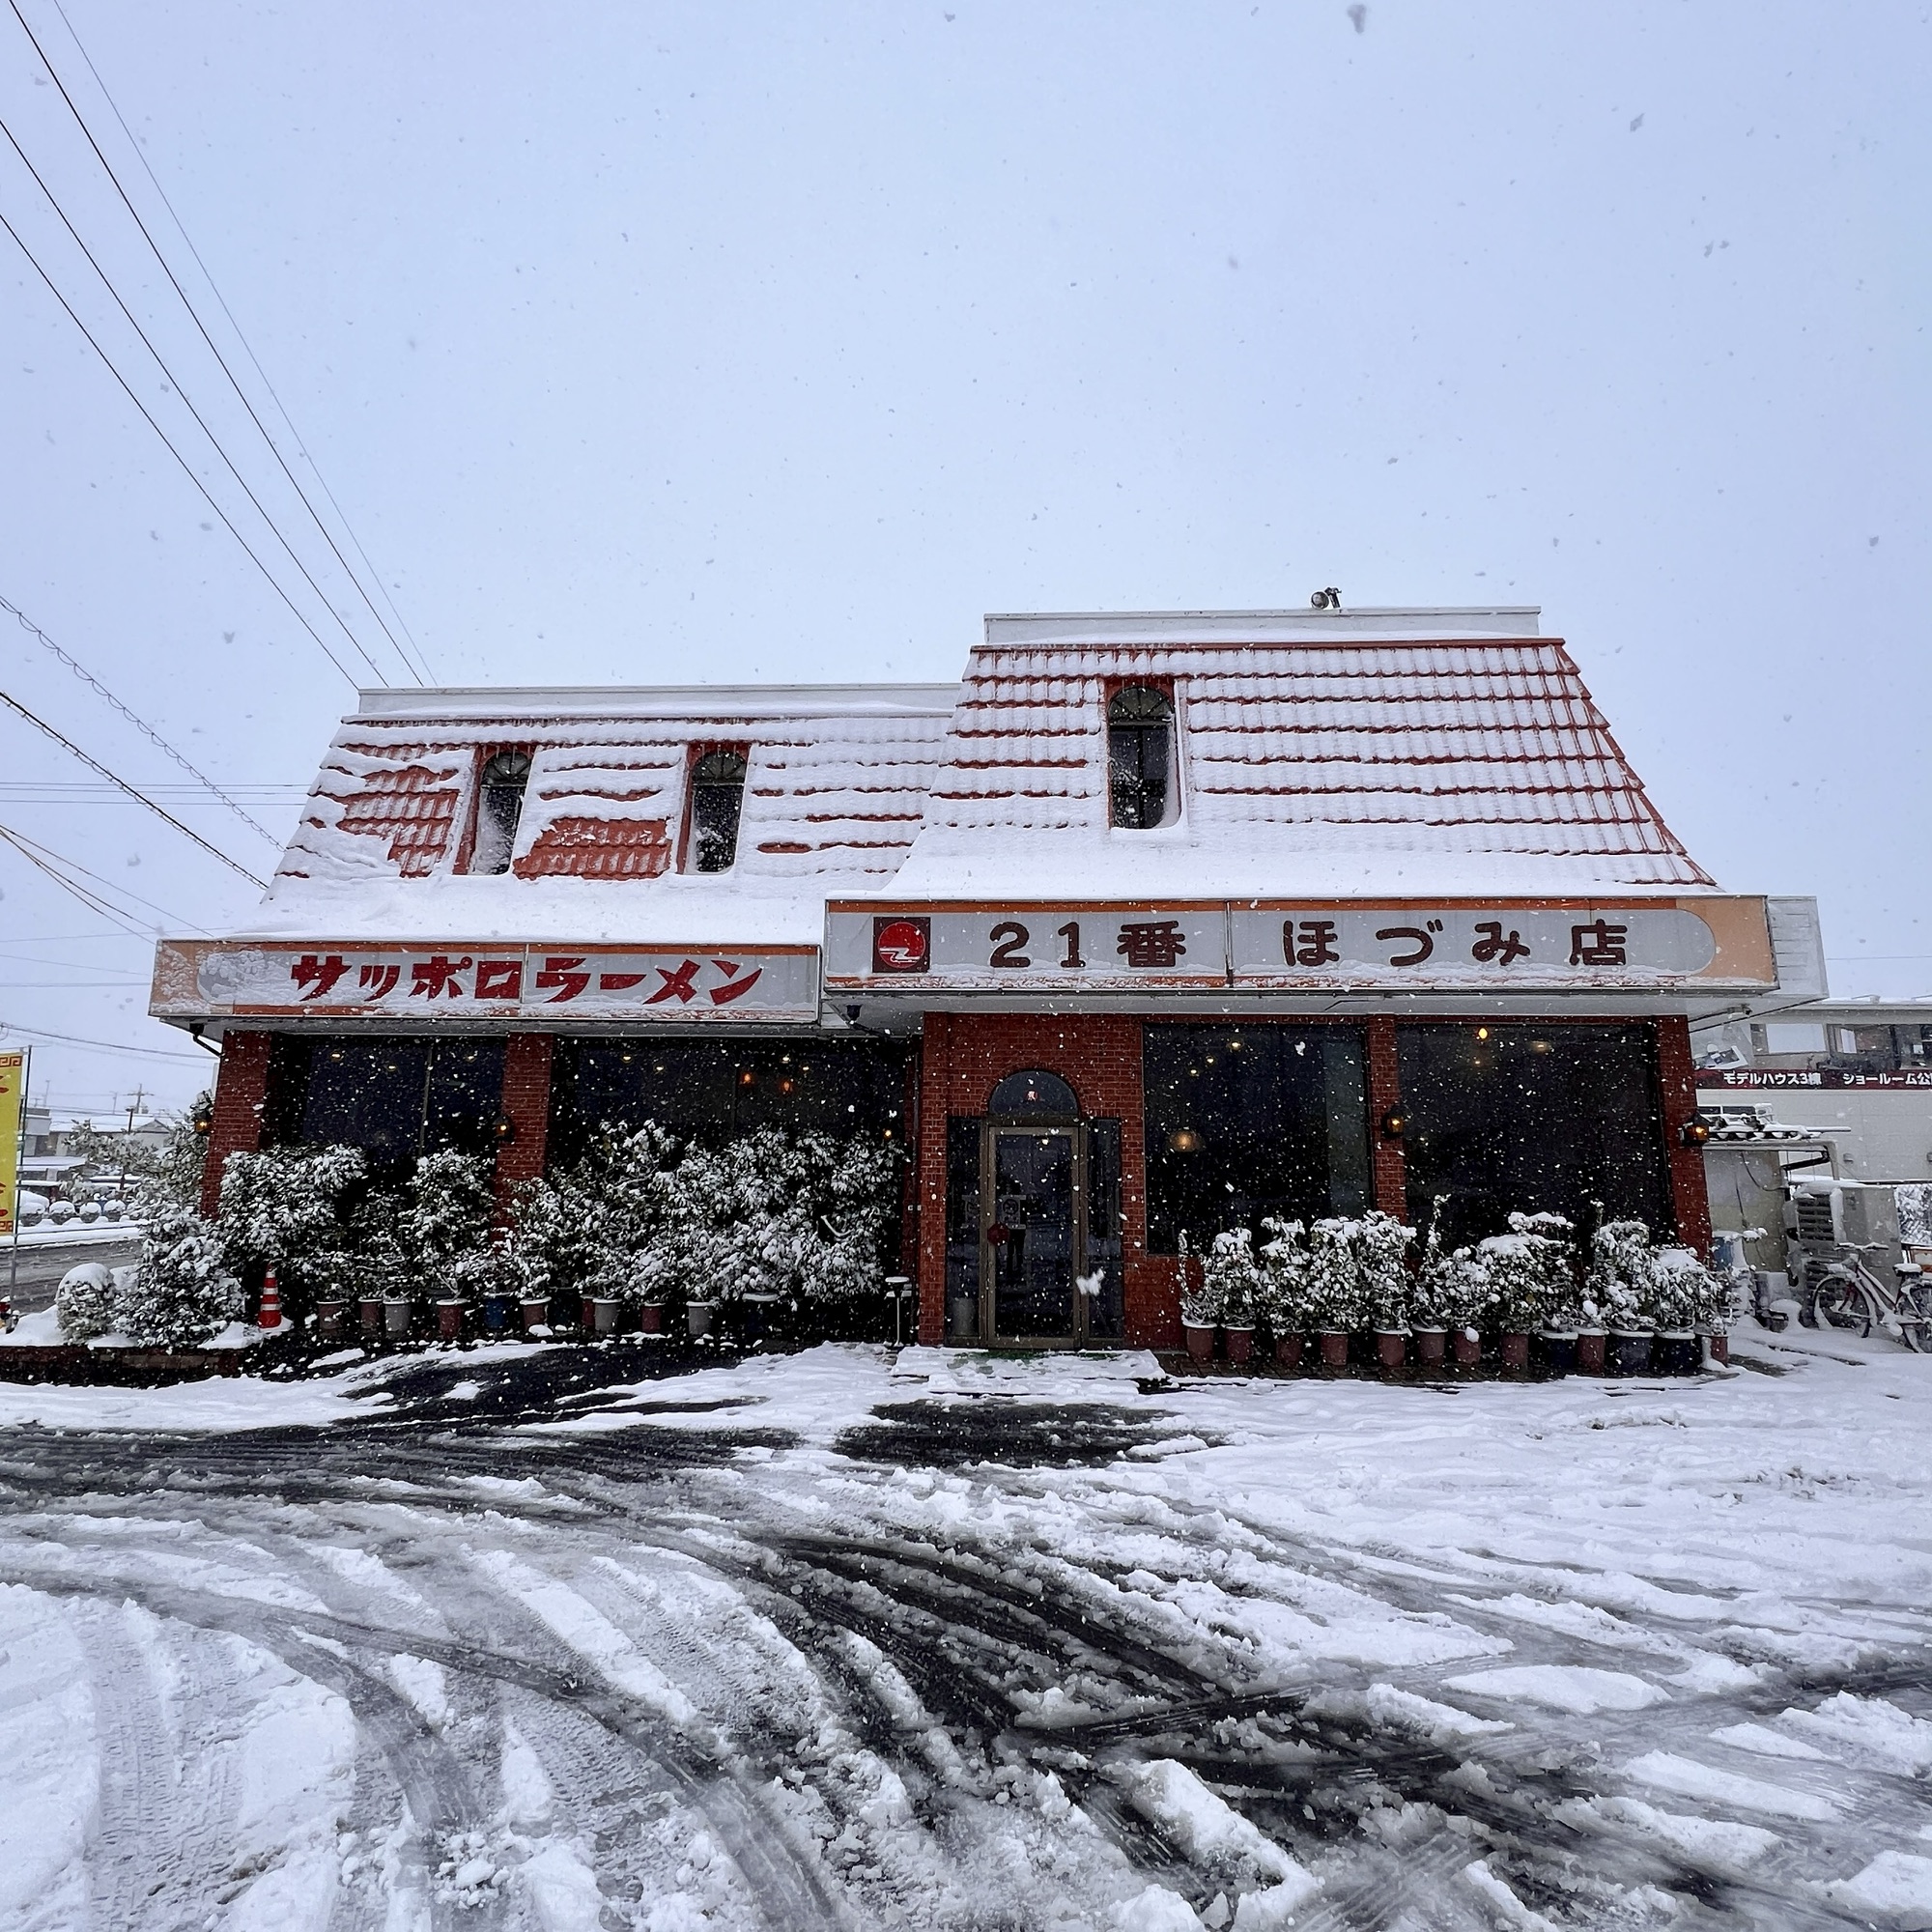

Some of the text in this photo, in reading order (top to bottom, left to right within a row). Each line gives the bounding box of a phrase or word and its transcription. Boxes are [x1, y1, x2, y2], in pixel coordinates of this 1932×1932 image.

[990, 919, 1628, 968] 21番 ほづみ店
[291, 954, 763, 1007] サッポロラーメン
[1842, 1072, 1932, 1085] ショールーム公
